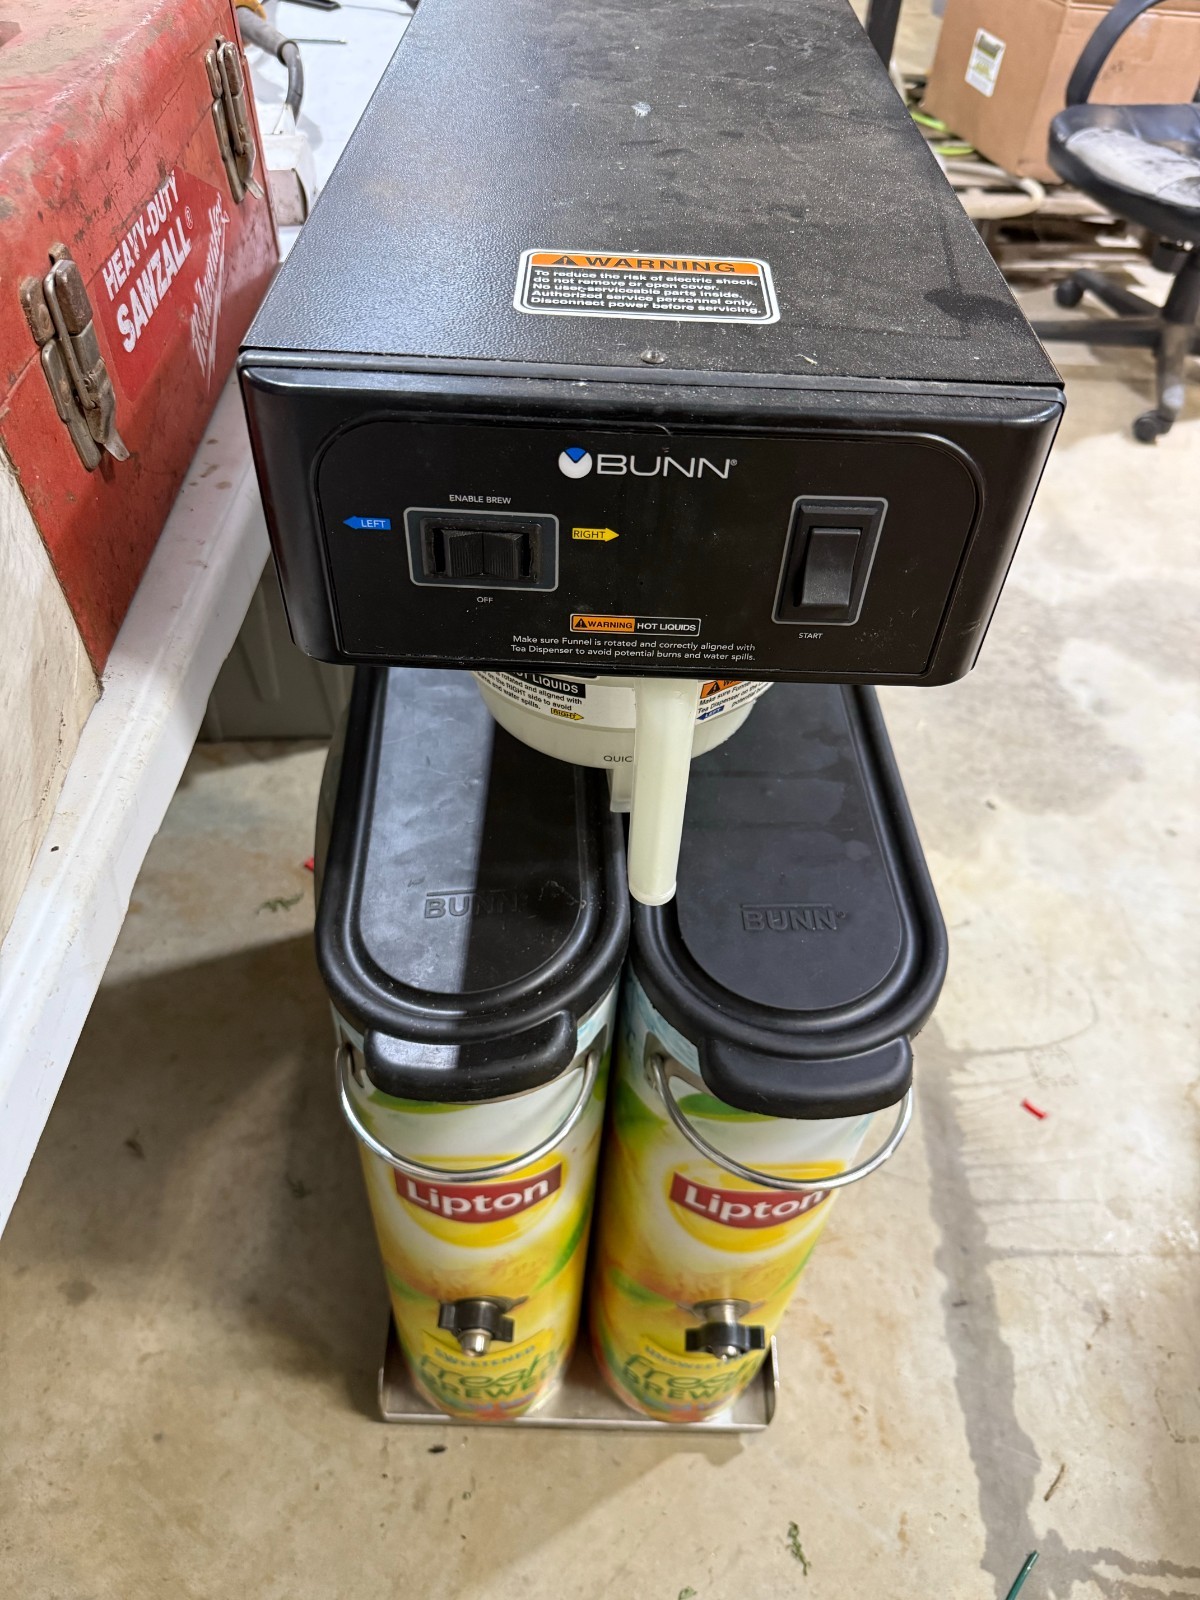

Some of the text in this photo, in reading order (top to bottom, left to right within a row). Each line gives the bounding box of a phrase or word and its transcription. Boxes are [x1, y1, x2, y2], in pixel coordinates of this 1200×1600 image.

[102, 170, 181, 300] HEAVY-DUTY
[584, 256, 735, 272] WARNING
[623, 273, 647, 281] risk
[666, 276, 712, 284] electric
[716, 278, 758, 286] shock,
[645, 282, 677, 290] open
[531, 290, 603, 299] Authorized
[656, 296, 721, 305] personnel
[554, 284, 661, 295] user-serviceable
[663, 290, 697, 298] parts
[700, 291, 743, 299] inside.
[530, 297, 605, 307] Disconnect
[652, 303, 695, 311] before
[697, 305, 761, 314] servicing.
[449, 494, 512, 504] ENABLE BREW
[360, 519, 386, 528] LEFT
[573, 529, 606, 540] RIGHT
[588, 620, 697, 632] WARNING HOT LIQUIDS
[512, 635, 538, 643] Make
[562, 637, 592, 646] Funnel
[594, 638, 601, 646] is
[640, 640, 657, 648] and
[659, 641, 698, 651] correctly
[700, 642, 734, 652] aligned
[736, 643, 756, 651] with
[798, 632, 823, 640] START
[511, 644, 526, 652] Tea
[528, 645, 573, 655] Dispenser
[587, 648, 612, 656] avoid
[614, 649, 655, 658] potential
[657, 650, 682, 658] burns
[684, 651, 701, 659] and
[731, 653, 756, 662] spills.
[501, 674, 582, 705] rotated and aligned with
[532, 674, 579, 694] LIQUIDS
[506, 680, 526, 697] RIGHT
[527, 693, 542, 703] side
[552, 701, 572, 711] avoid
[603, 755, 633, 763] QUIC
[407, 1178, 549, 1215] Lipton
[686, 1186, 824, 1222] Lipton
